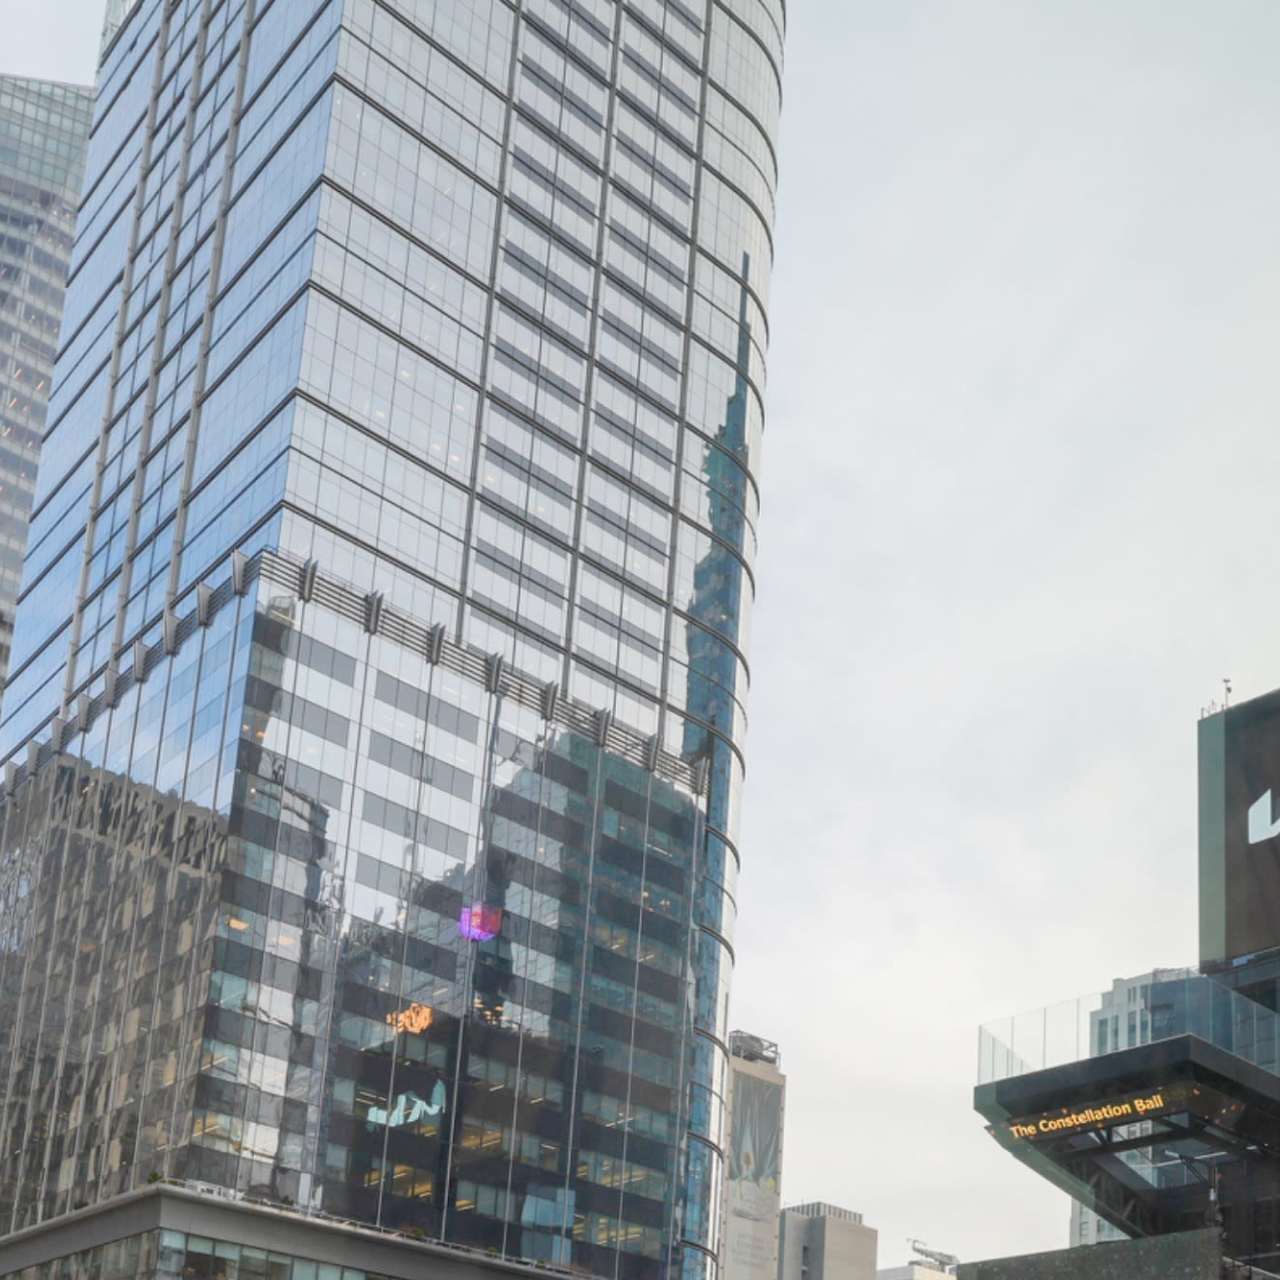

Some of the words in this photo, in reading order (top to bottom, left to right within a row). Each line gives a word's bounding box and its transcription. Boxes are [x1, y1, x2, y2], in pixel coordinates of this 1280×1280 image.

[1009, 1123, 1037, 1138] The
[1039, 1103, 1132, 1133] Constellation
[1134, 1094, 1165, 1112] Ball
